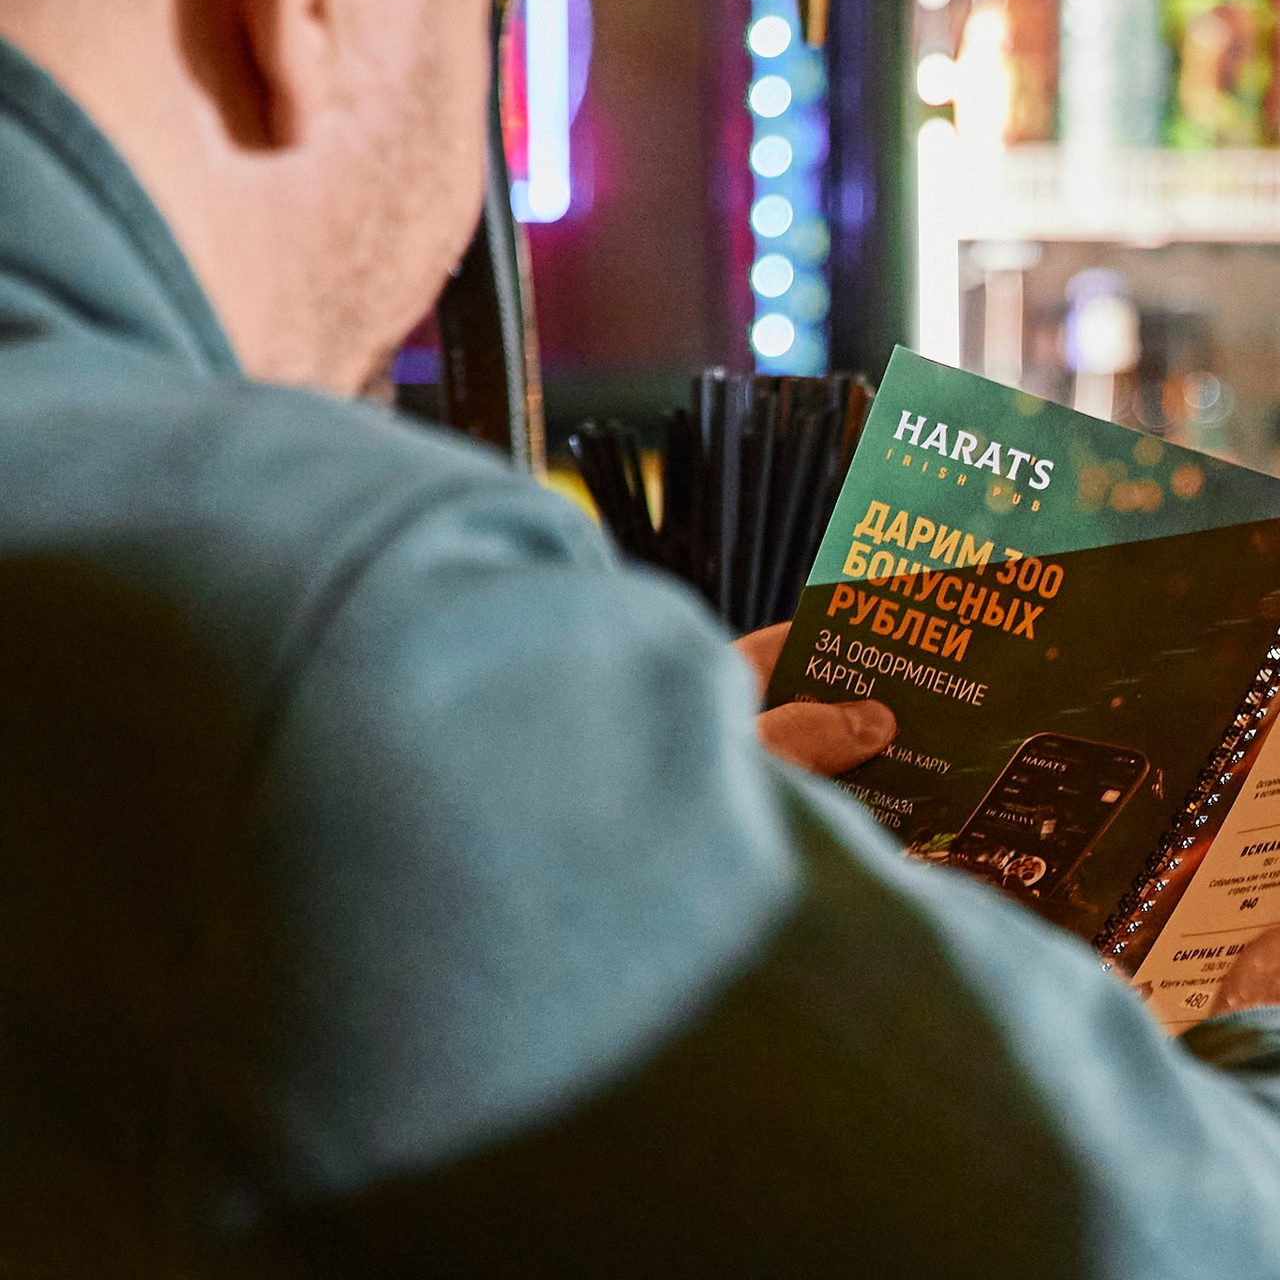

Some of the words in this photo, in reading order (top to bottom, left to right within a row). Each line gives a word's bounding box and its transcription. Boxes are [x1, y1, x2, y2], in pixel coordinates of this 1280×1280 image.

[886, 448, 967, 486] IRISH
[992, 486, 1041, 512] PUB
[892, 409, 1055, 491] HARAT'S
[852, 499, 994, 575] ДАРИМ
[996, 547, 1064, 599] 300
[842, 540, 1045, 640] БОНУСНЫХ
[826, 582, 973, 663] РУБЛЕЙ
[804, 655, 876, 698] КАРТЫ
[814, 629, 841, 657] ЗА
[846, 640, 989, 706] ОФОРМЛЕНИЕ
[897, 748, 913, 764] НА
[915, 754, 952, 775] КАРТУ
[871, 791, 914, 816] ЗАКАЗА
[1172, 946, 1225, 962] СЫРНЫЕ
[1184, 993, 1210, 1009] 480
